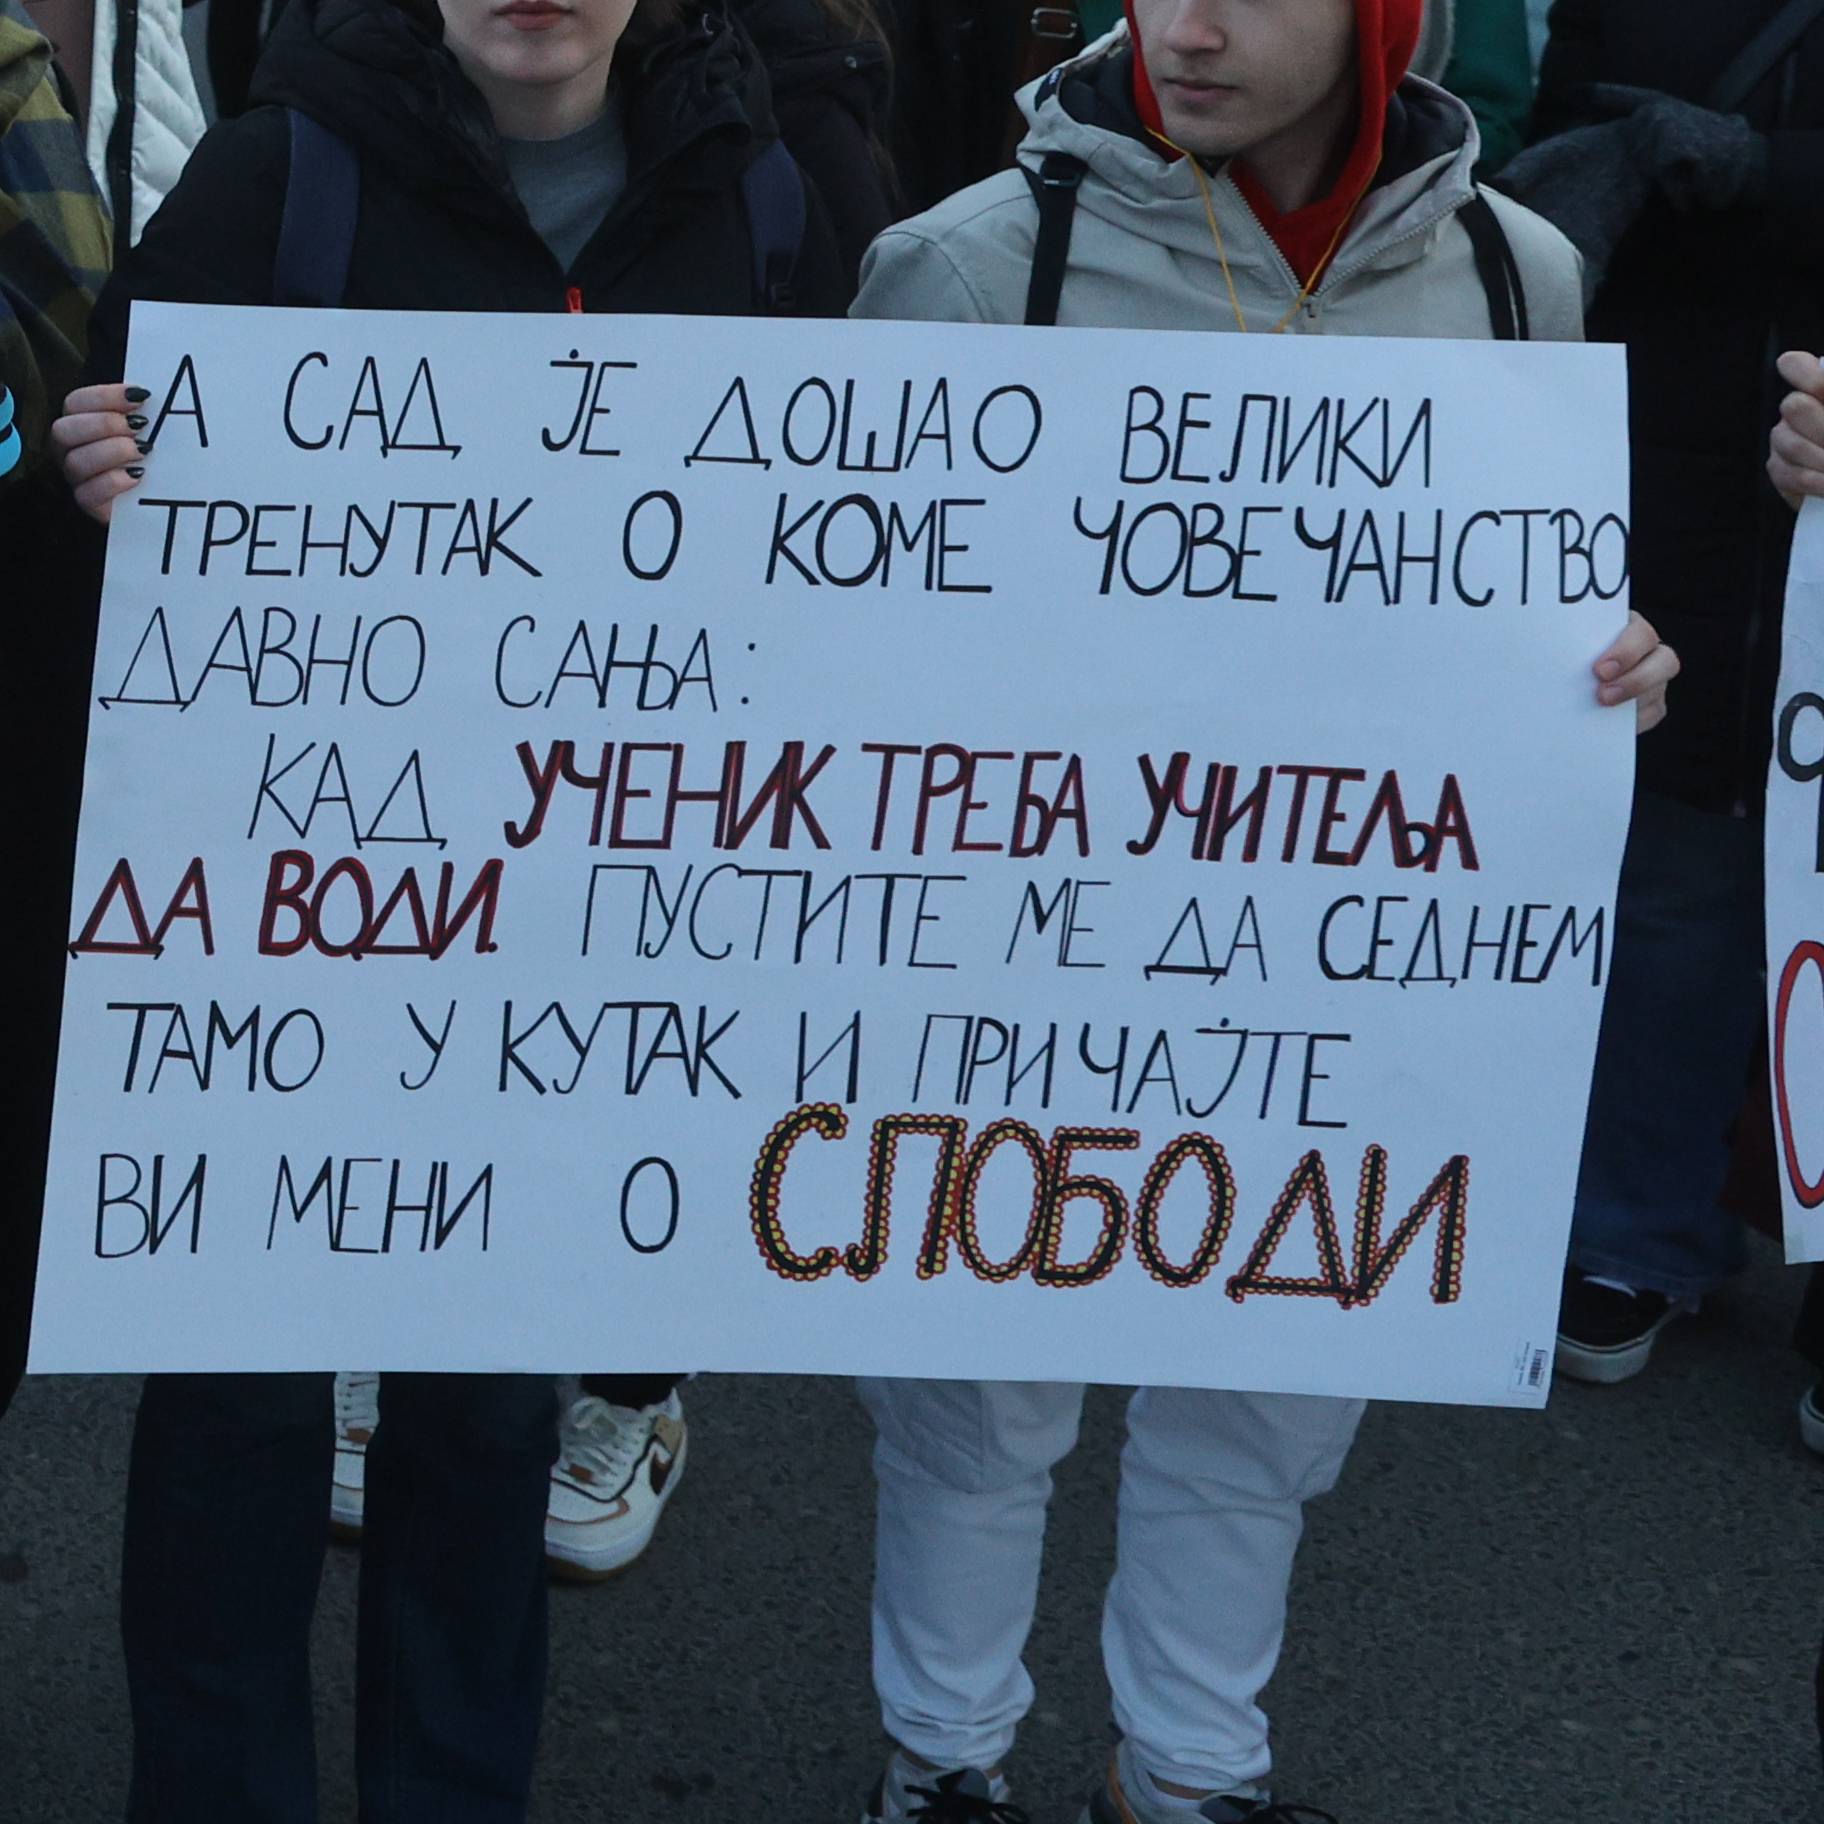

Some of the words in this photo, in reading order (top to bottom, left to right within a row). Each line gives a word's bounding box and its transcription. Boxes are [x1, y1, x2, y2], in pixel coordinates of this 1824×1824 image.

[147, 353, 209, 453] А
[282, 351, 463, 459] САД
[540, 348, 638, 457] ЈЕ
[684, 375, 1044, 472] ДОШАО
[1120, 385, 1434, 488] ВЕЛИКИ
[138, 495, 543, 577] ТРЕНУТАК
[621, 489, 684, 581] О
[765, 491, 993, 593] КОМЕ
[1073, 495, 1630, 608] ЧОВЕЧАНСТВО
[97, 605, 426, 714] ДАВНО
[247, 732, 449, 850] КАД
[504, 740, 832, 852] УЧЕНИК
[860, 741, 1091, 859] ТРЕБА
[1124, 751, 1480, 874] УЧИТЕЉА
[68, 855, 215, 959] ДА
[579, 863, 958, 970] ПУСТИТЕ
[1005, 877, 1112, 970] МЕ
[1144, 894, 1268, 989] ДА
[1317, 893, 1606, 991] СЕДНЕМ
[105, 999, 326, 1095] ТАМО
[398, 998, 459, 1093] У
[498, 997, 744, 1102] КУТАК
[795, 1008, 863, 1105] И
[910, 1012, 1352, 1131] ПРИЧАЈТЕ
[94, 1152, 203, 1259] ВИ
[266, 1153, 495, 1256] МЕНИ
[618, 1155, 680, 1254] О
[749, 1101, 1471, 1308] СЛОБОДИ
